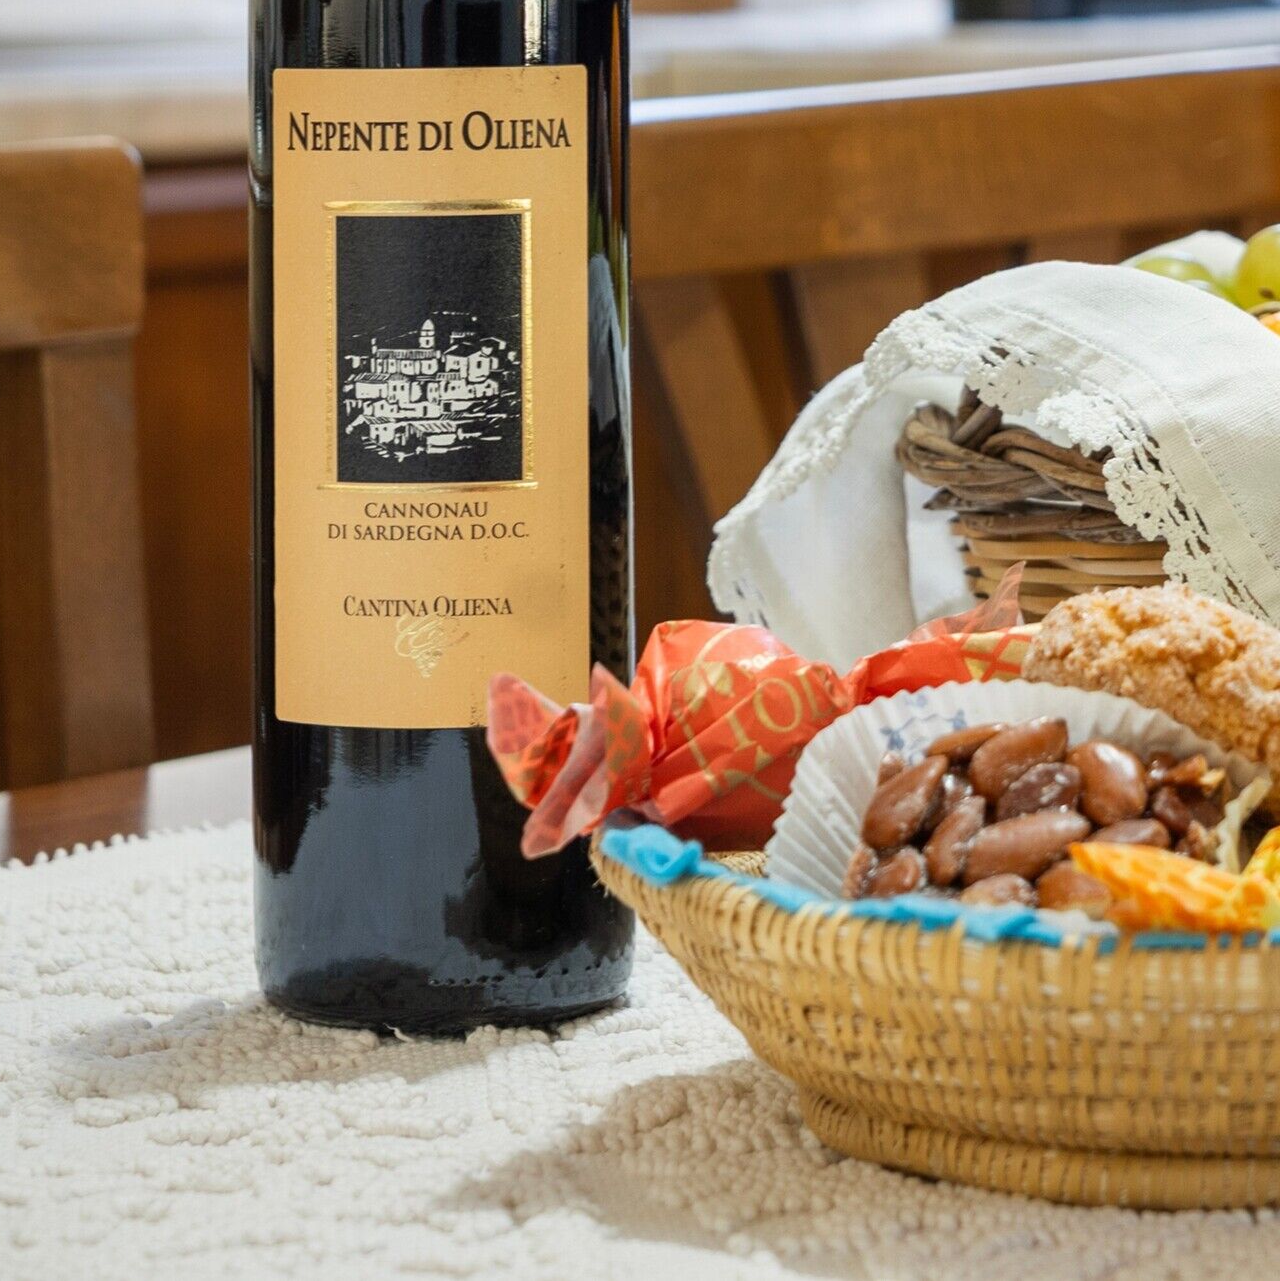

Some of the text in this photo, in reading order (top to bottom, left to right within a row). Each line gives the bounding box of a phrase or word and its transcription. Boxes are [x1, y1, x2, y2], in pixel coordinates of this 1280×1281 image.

[287, 110, 571, 151] NEPENTE DI OLIENA
[364, 501, 488, 518] CANNONAU
[328, 522, 529, 541] DI SARDEGNA D.O.C.
[343, 595, 513, 617] CANTINA OLIENA
